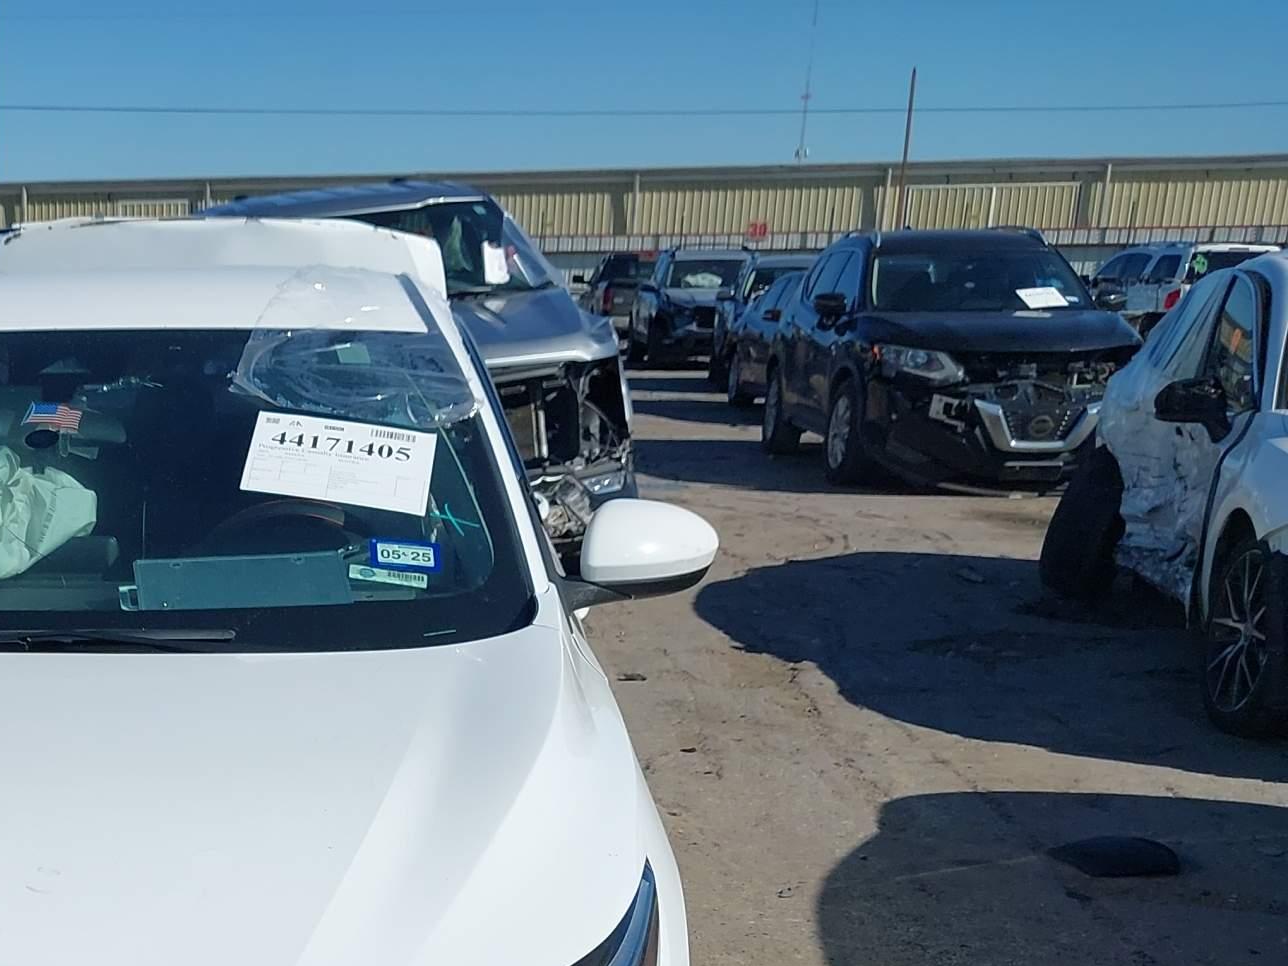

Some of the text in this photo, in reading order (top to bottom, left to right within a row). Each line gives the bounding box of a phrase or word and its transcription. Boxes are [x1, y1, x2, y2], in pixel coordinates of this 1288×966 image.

[272, 431, 412, 462] 44171405
[381, 548, 401, 560] 05
[411, 551, 431, 563] 25
